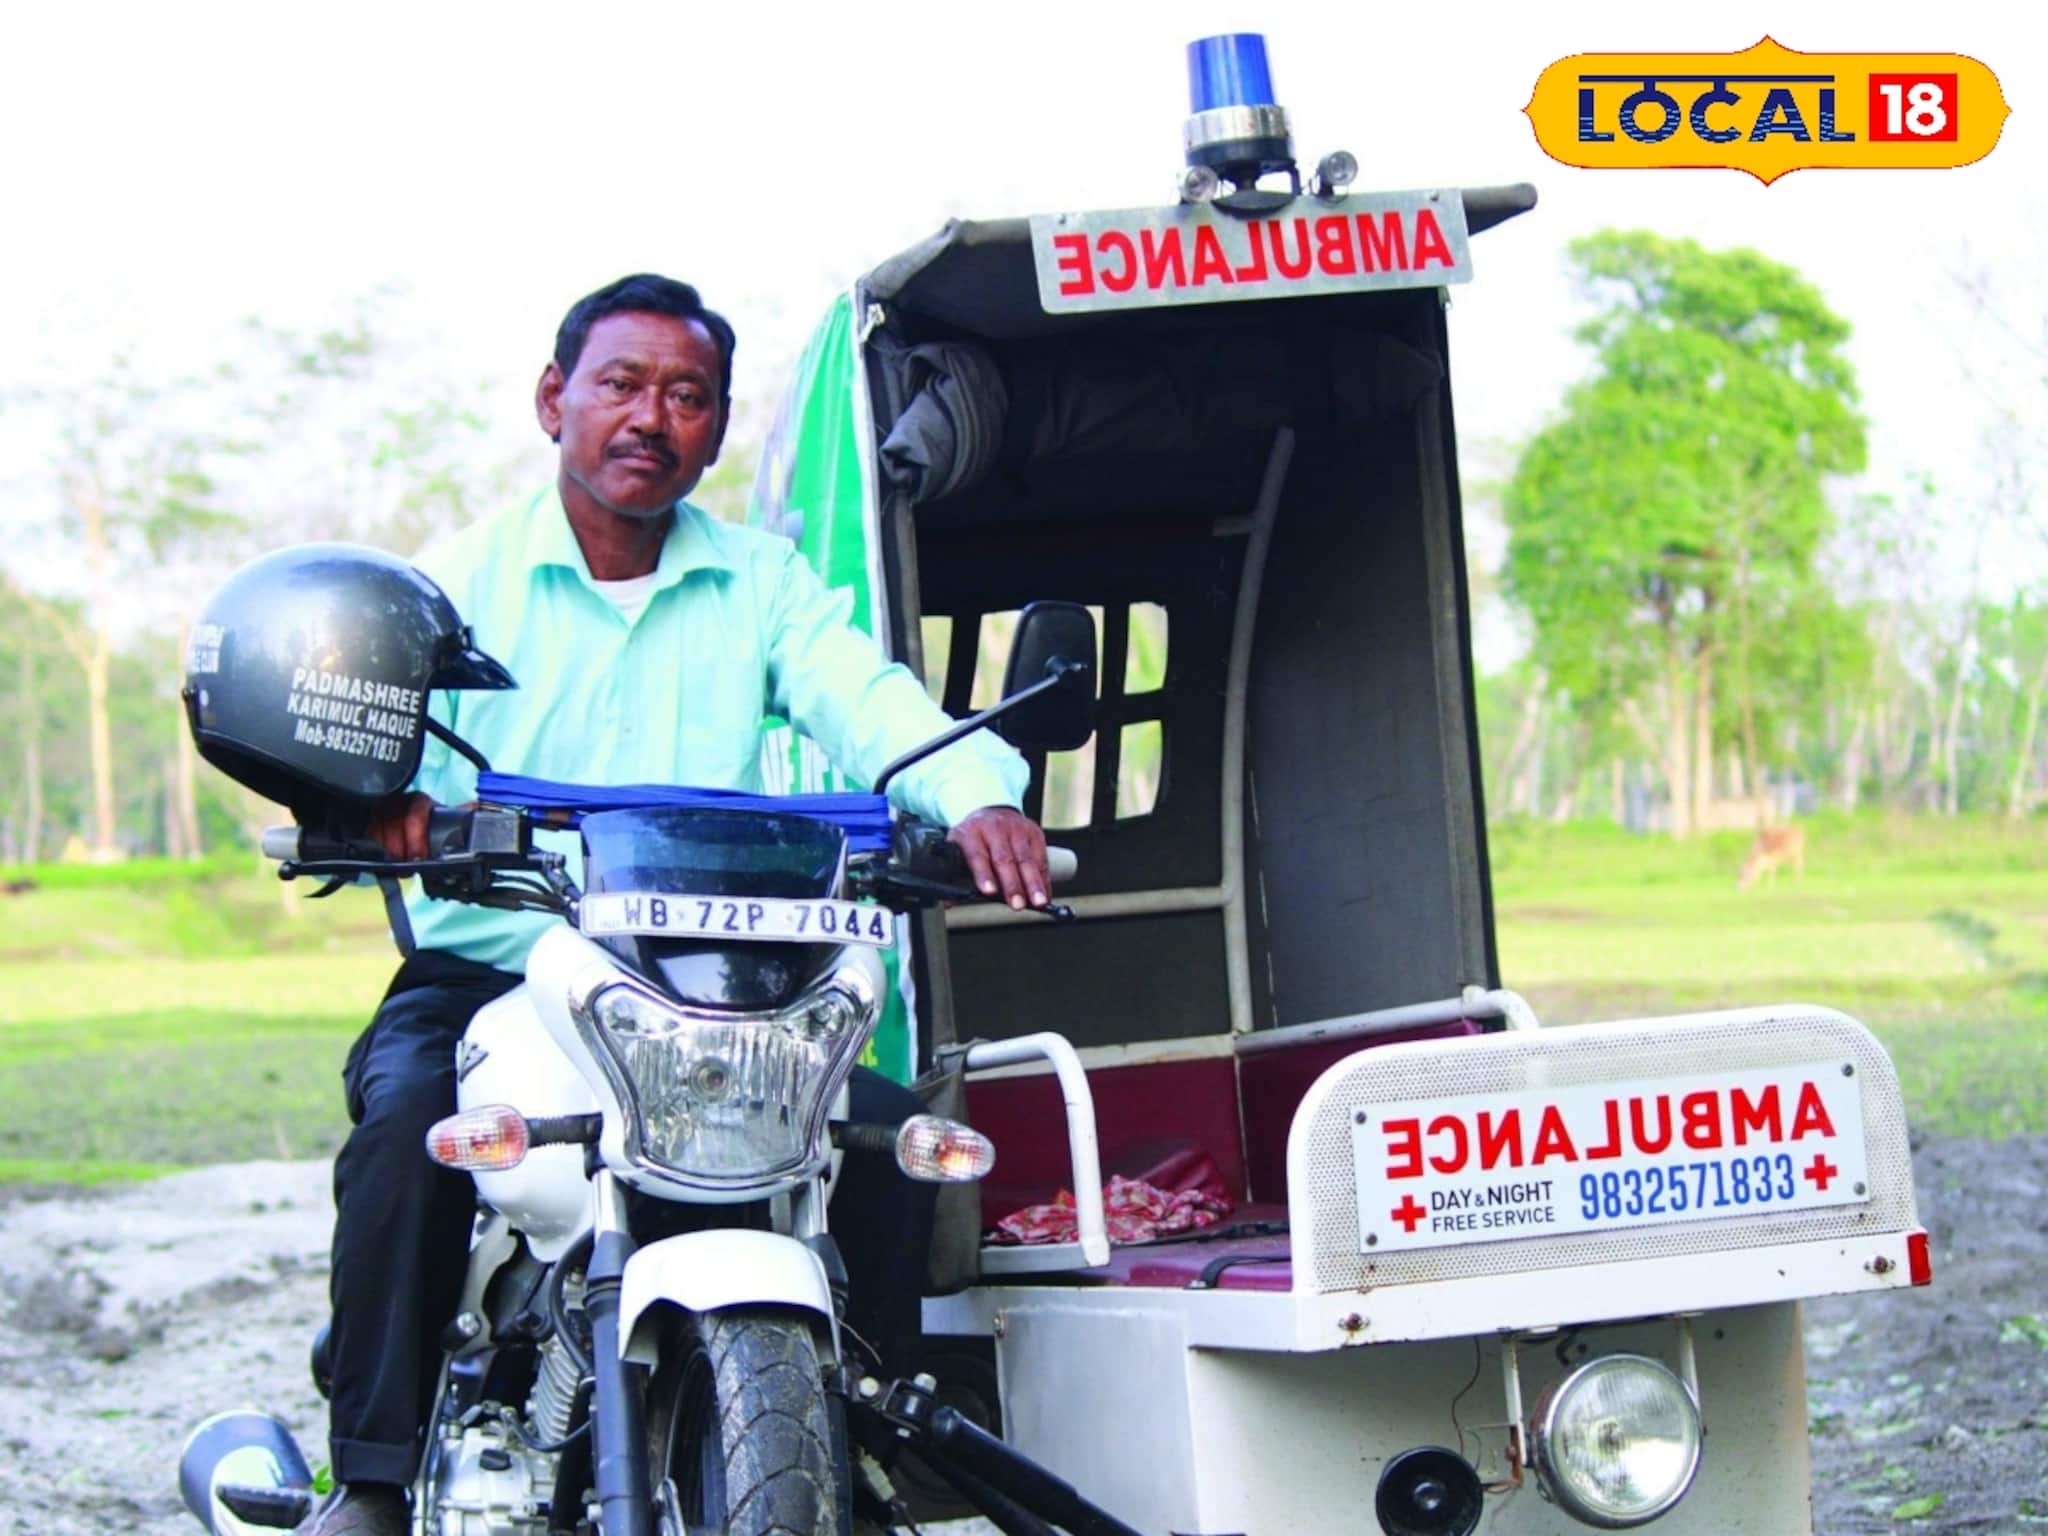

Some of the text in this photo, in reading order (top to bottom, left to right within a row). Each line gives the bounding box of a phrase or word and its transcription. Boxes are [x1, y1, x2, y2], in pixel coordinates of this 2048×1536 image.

[292, 667, 421, 714] PADMASHREE
[366, 709, 417, 739] HAQUE
[624, 897, 885, 940] WB 72P 7044
[1579, 1153, 1796, 1220] 9832571833
[1433, 1206, 1555, 1233] FREE SERVICE
